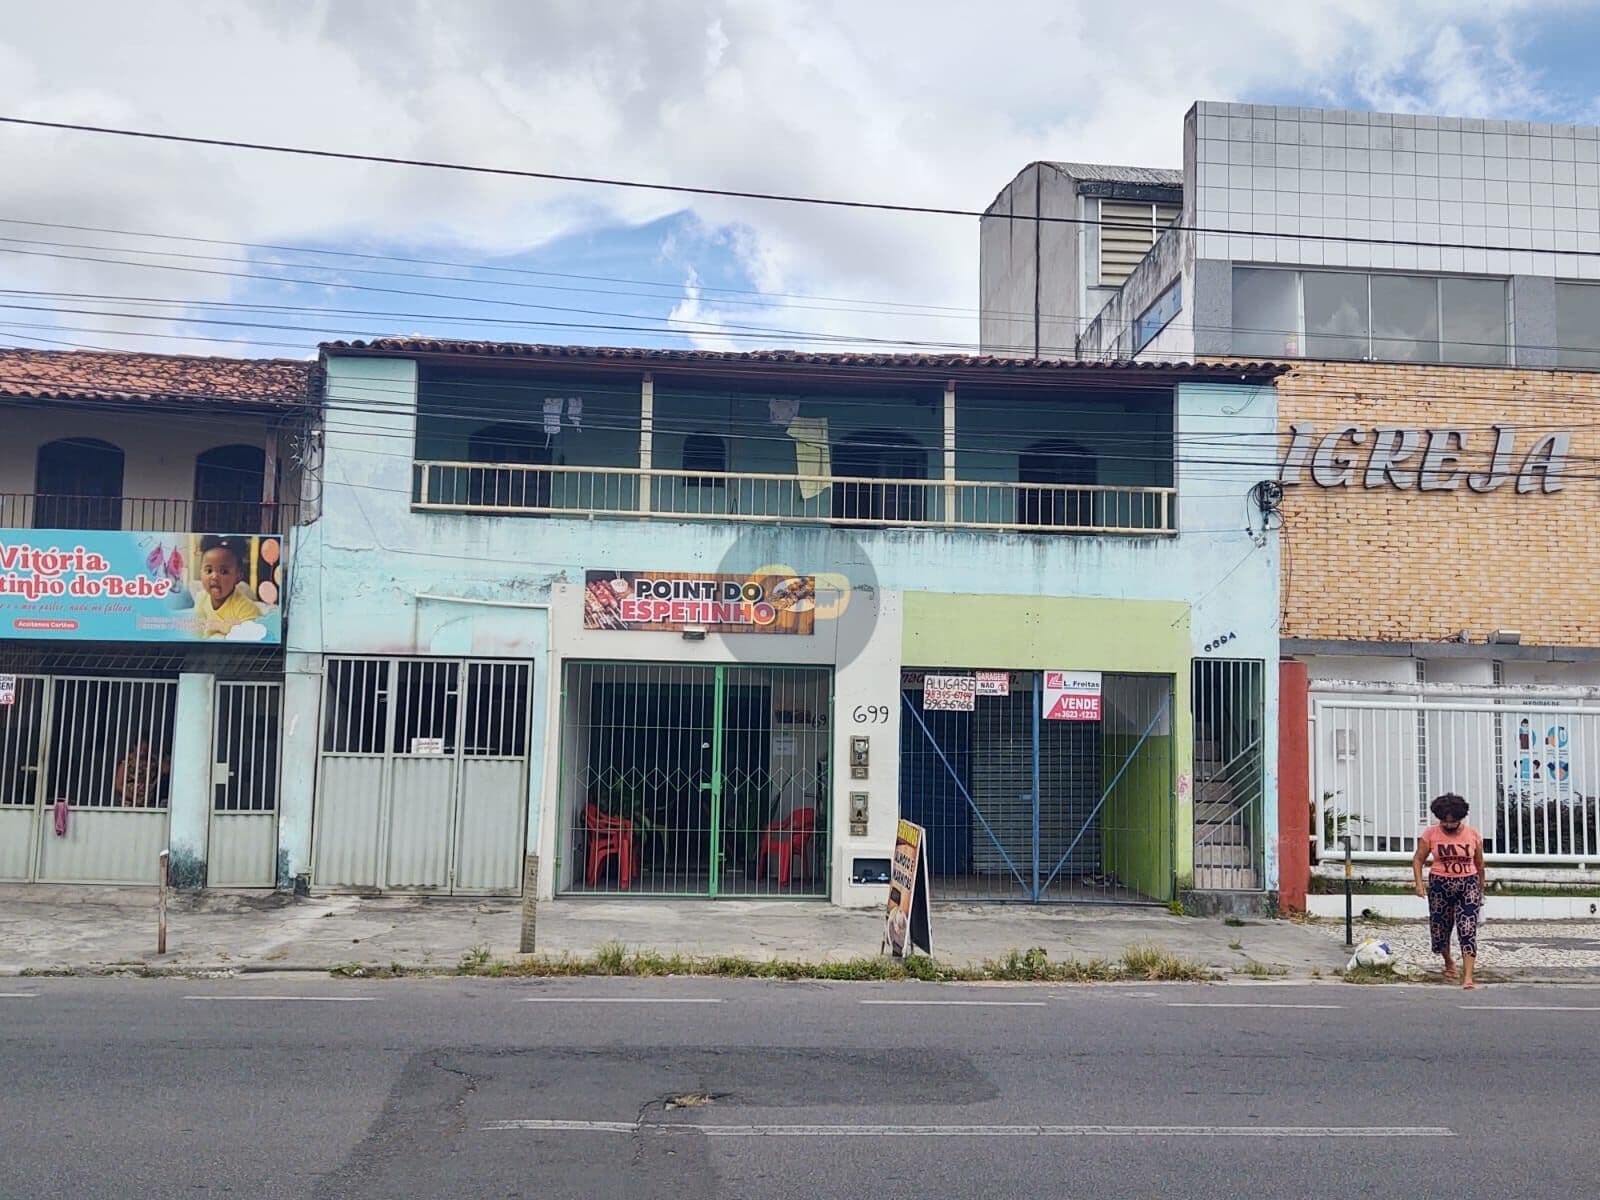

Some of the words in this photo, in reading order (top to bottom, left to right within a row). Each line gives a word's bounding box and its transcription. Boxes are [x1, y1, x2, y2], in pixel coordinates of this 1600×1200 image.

[1279, 421, 1571, 494] IGREJA
[0, 546, 108, 576] Vitória
[70, 575, 100, 595] do
[103, 577, 170, 597] Bebê
[636, 580, 715, 601] POINT
[723, 582, 762, 602] DO
[621, 599, 775, 624] ESPETINHO
[1072, 680, 1100, 688] Freitas
[1061, 698, 1099, 710] VENDE
[852, 705, 889, 724] 699
[1437, 844, 1470, 857] MY
[1443, 861, 1472, 874] YOU
